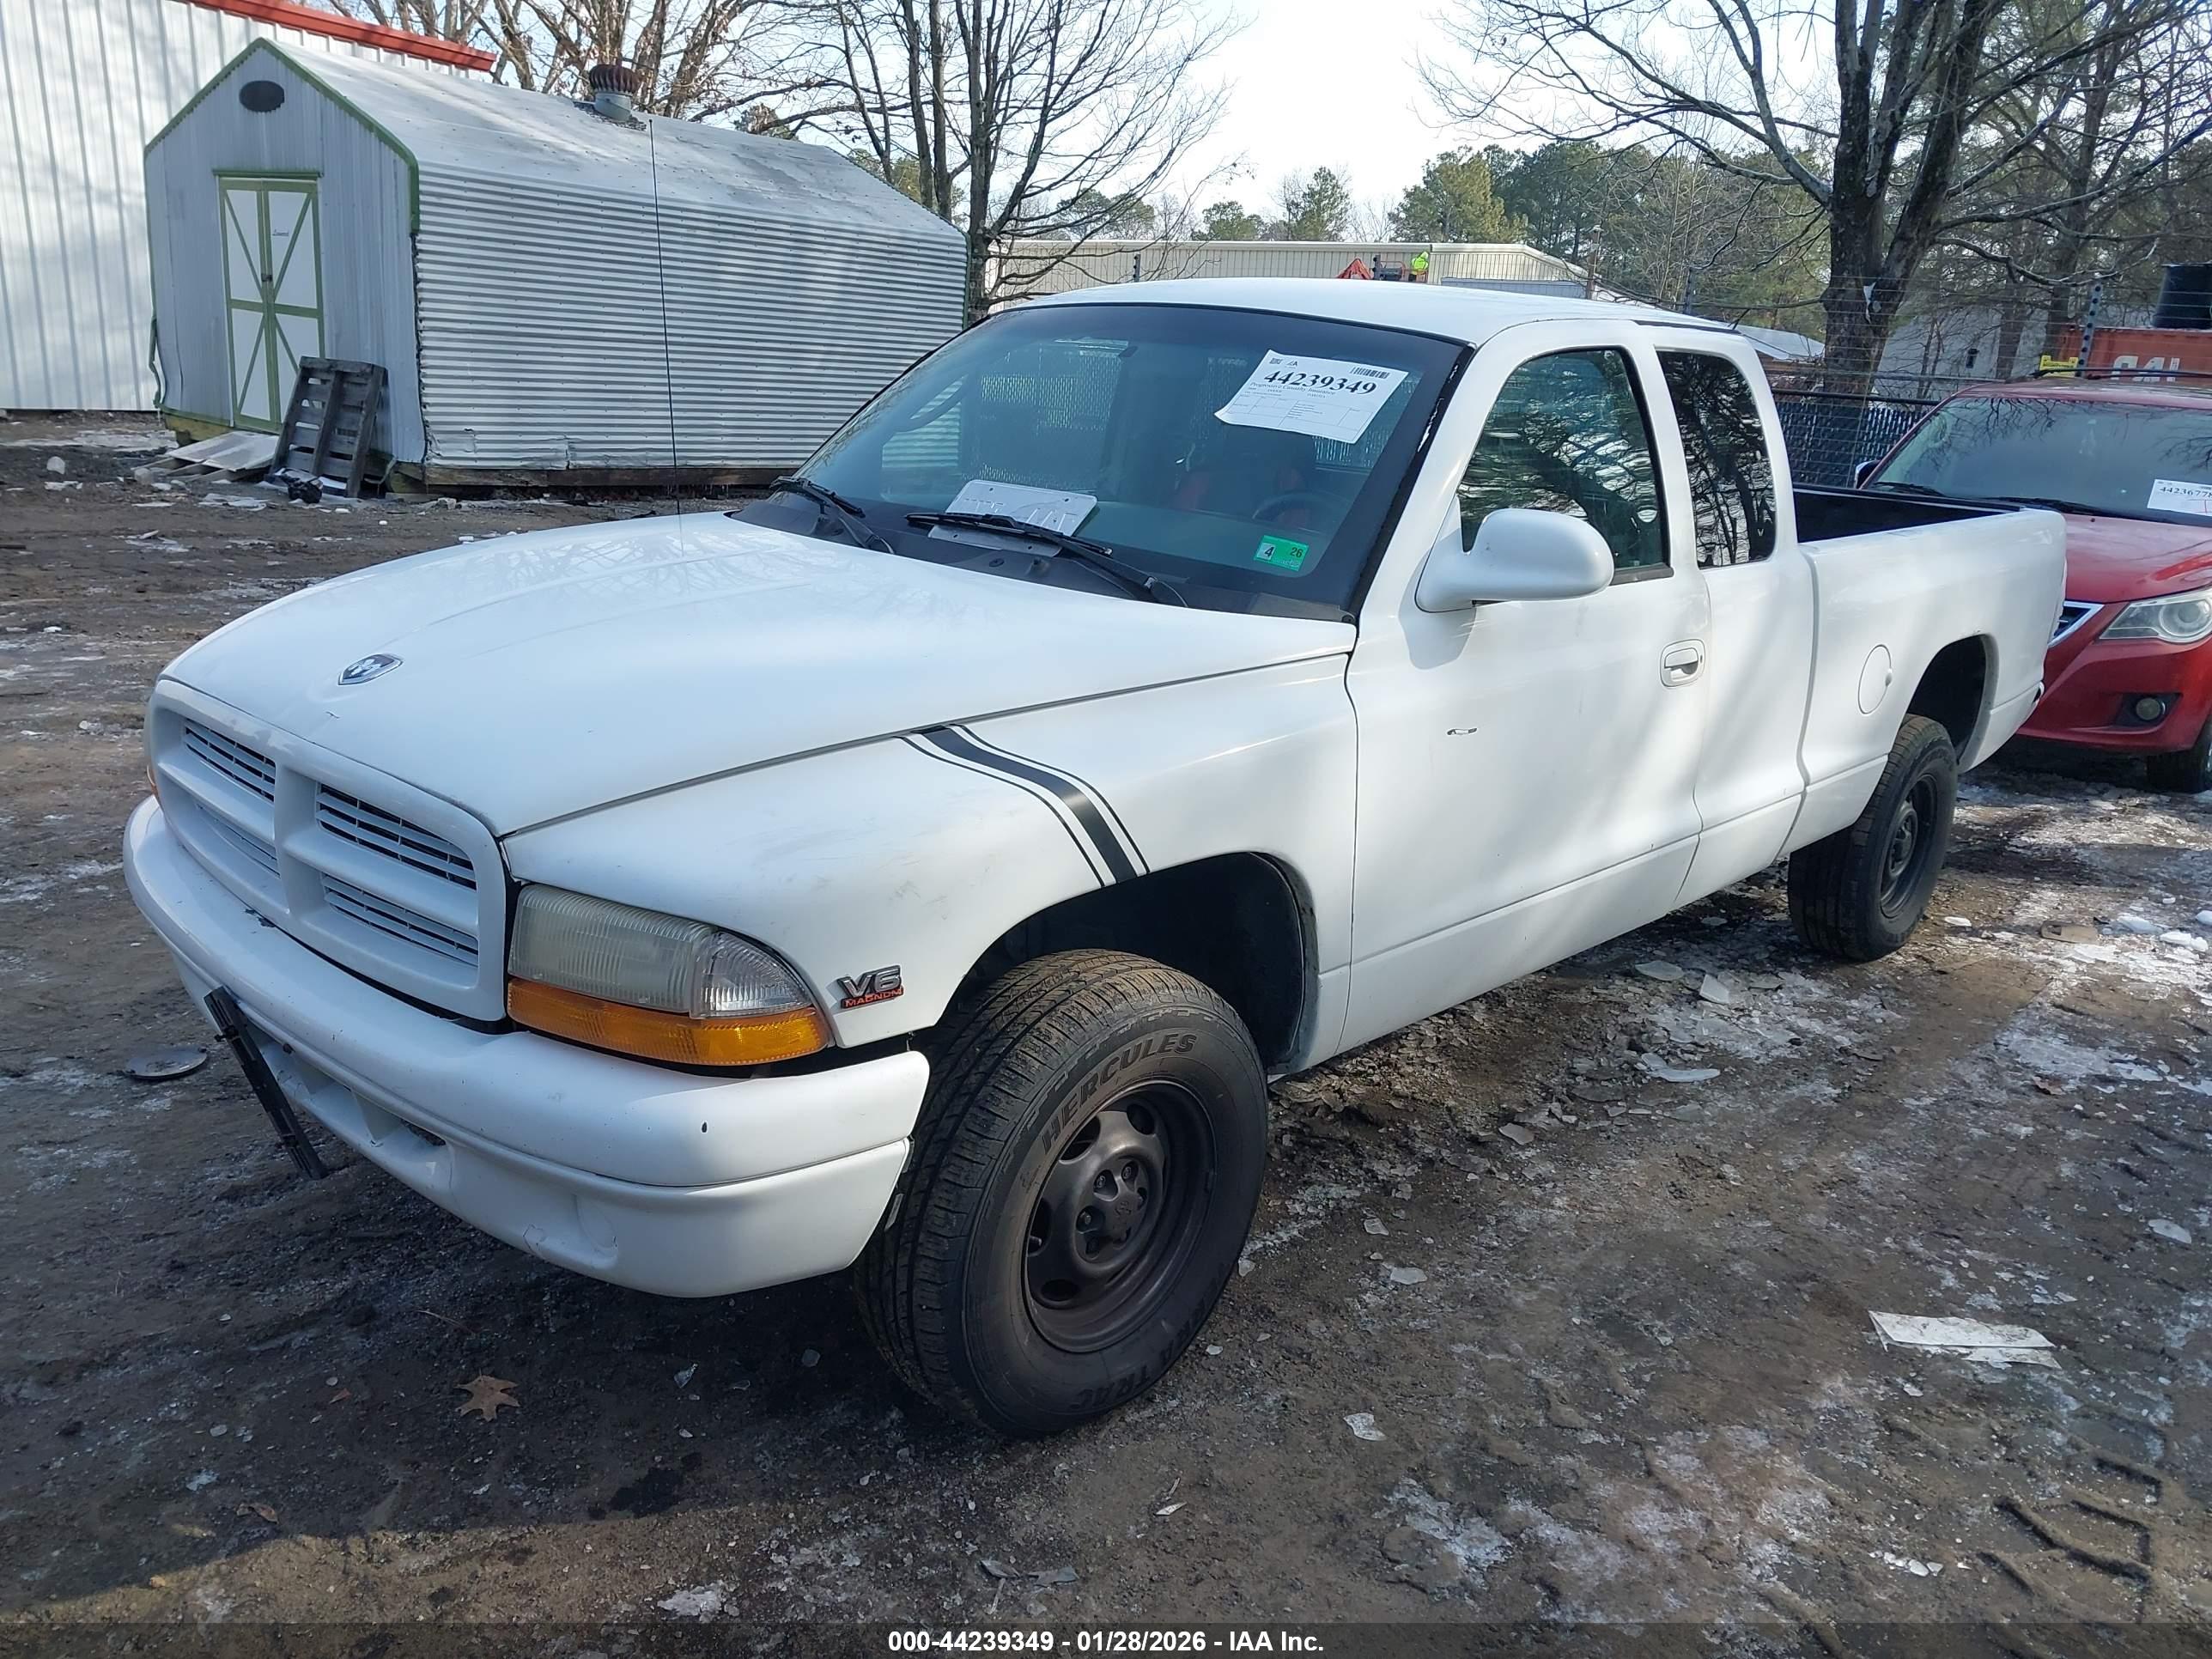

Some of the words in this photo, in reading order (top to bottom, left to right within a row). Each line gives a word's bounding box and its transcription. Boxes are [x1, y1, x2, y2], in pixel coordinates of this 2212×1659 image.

[1264, 371, 1376, 394] 44239349
[1264, 546, 1274, 557] 4
[1290, 547, 1304, 558] 26
[838, 965, 901, 997] V6
[1041, 1033, 1197, 1155] HERCULES
